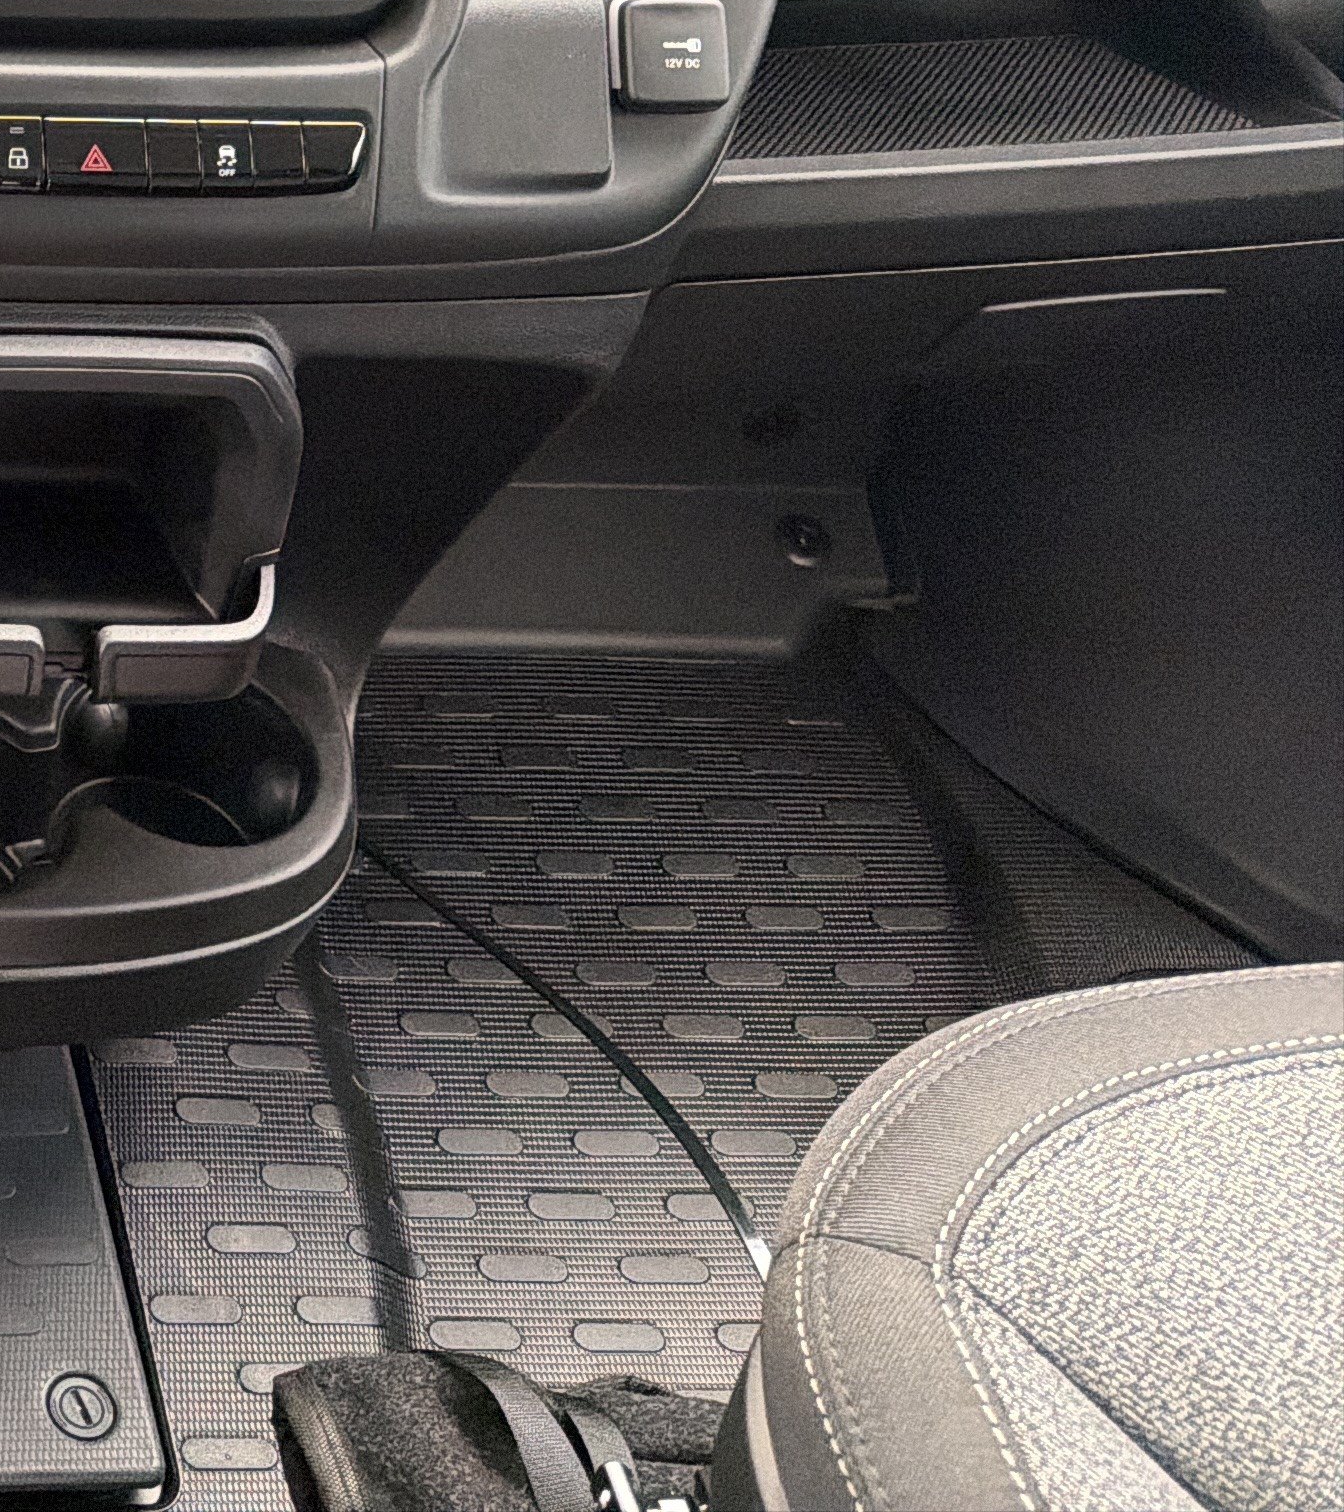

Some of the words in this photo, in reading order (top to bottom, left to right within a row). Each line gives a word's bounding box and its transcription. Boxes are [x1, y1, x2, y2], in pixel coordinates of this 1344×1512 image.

[664, 58, 682, 68] 12V
[684, 58, 700, 69] DC
[218, 168, 236, 177] OFF
